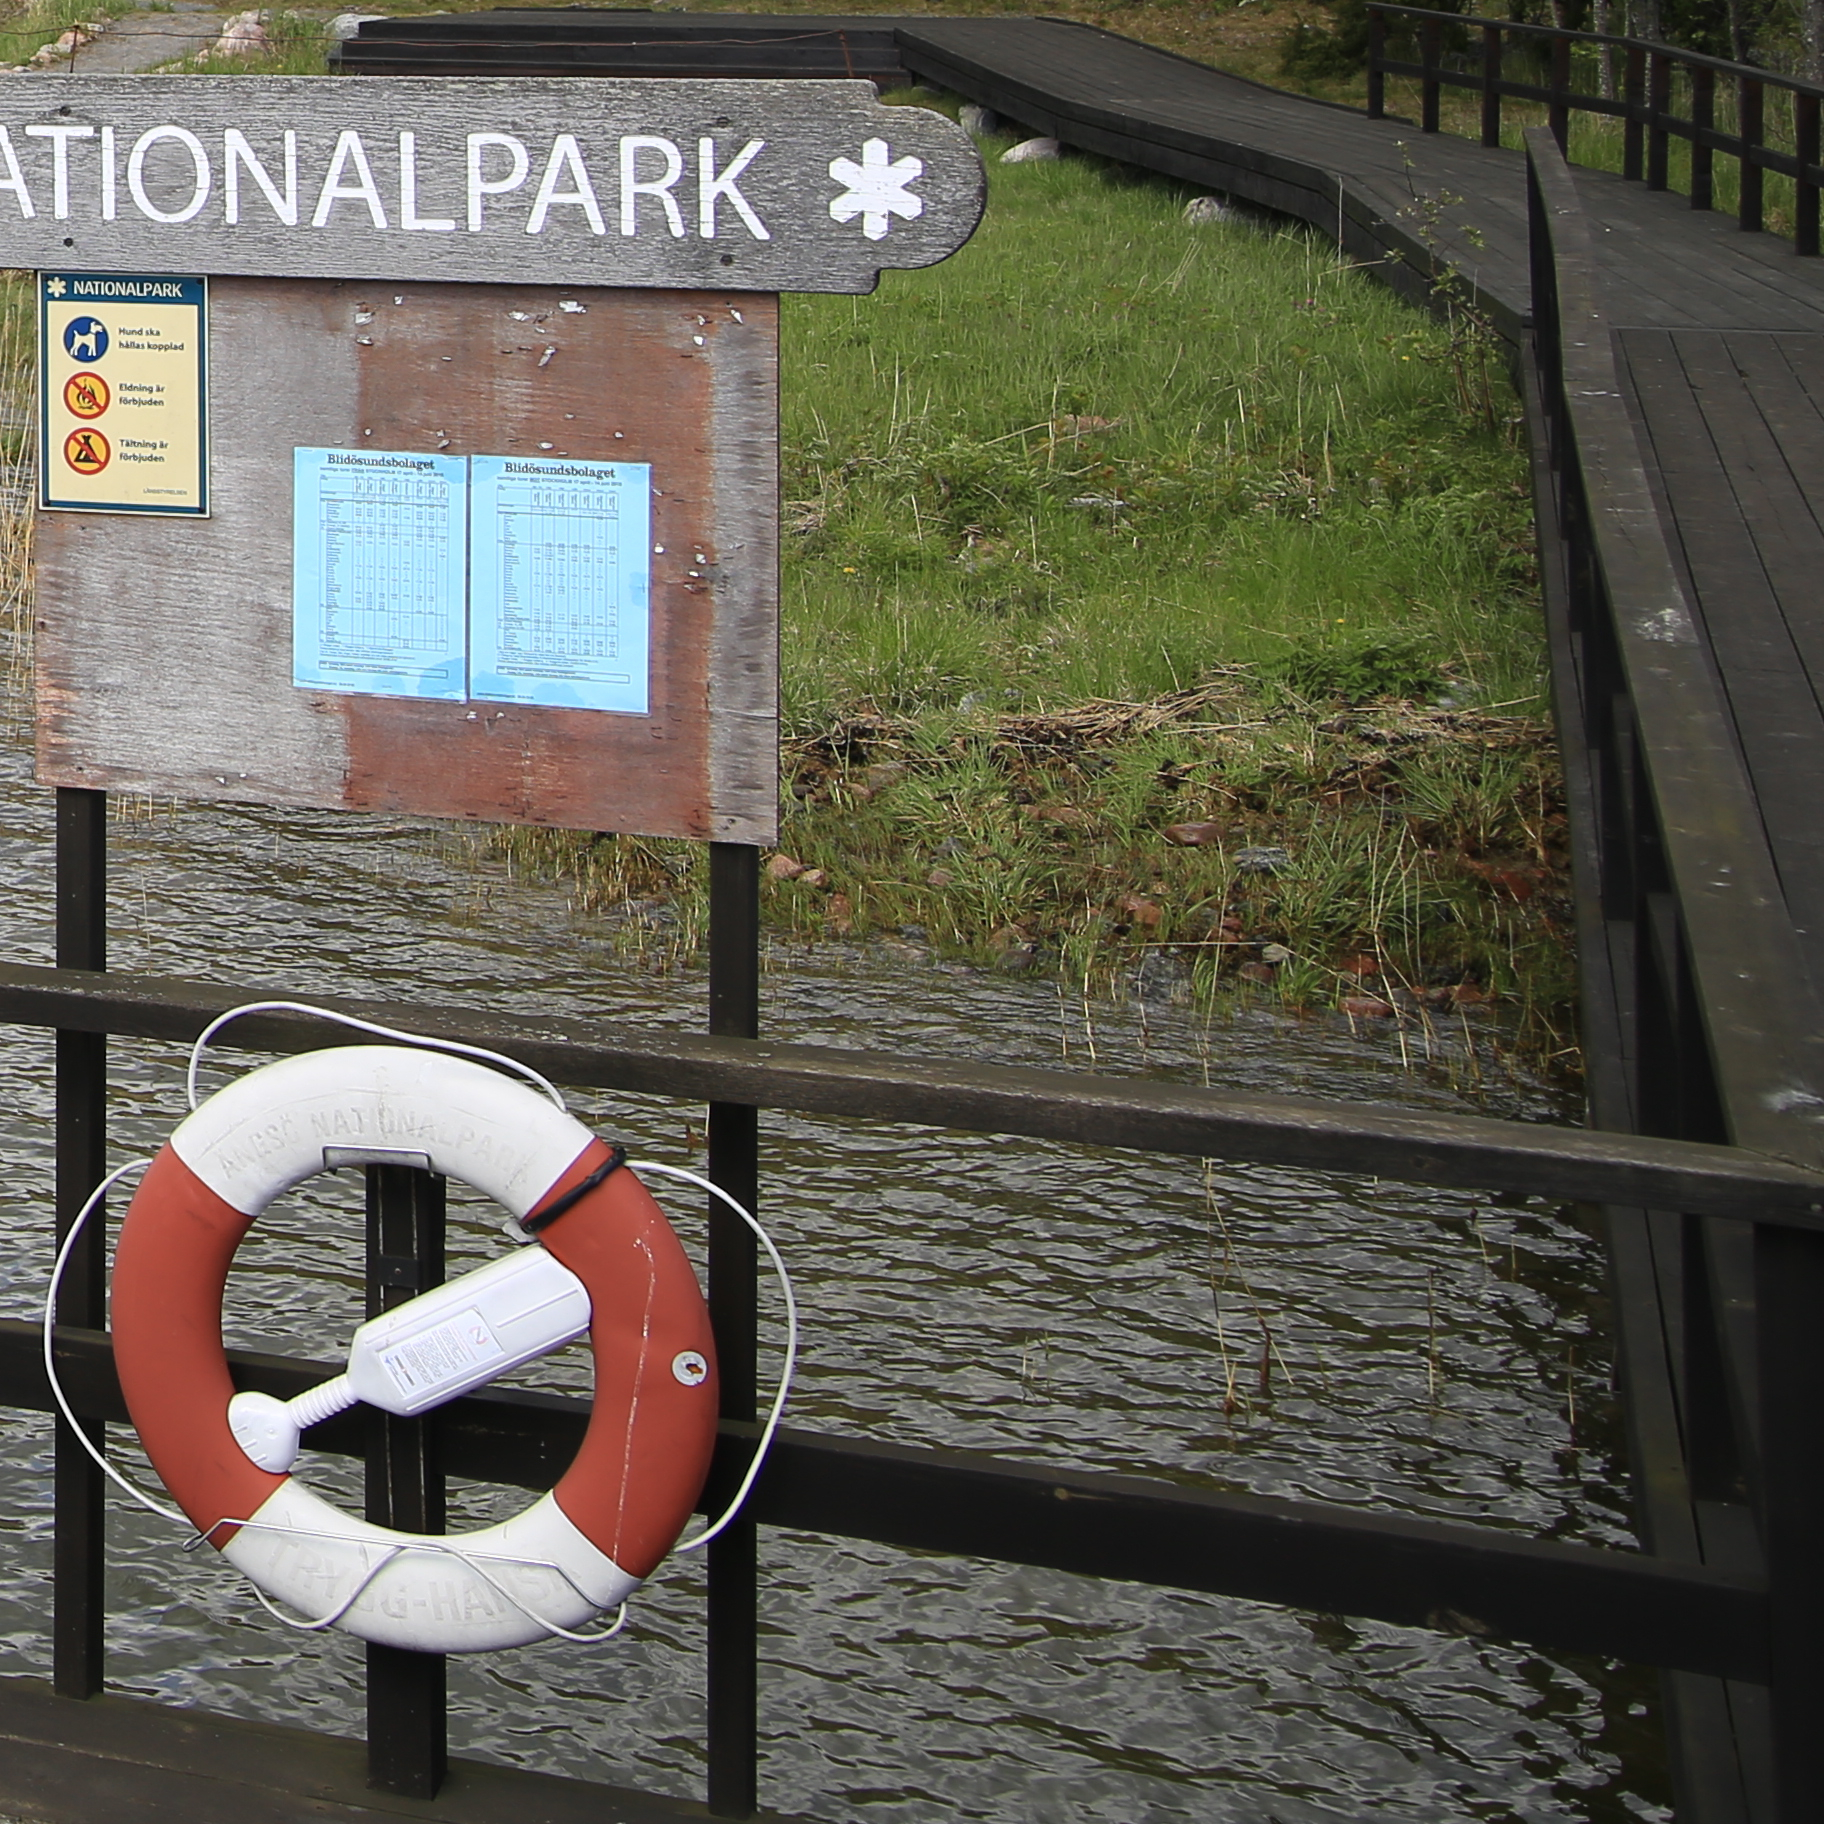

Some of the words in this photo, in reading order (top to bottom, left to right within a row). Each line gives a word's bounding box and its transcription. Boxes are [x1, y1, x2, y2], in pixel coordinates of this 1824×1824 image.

[73, 280, 183, 298] NATIONALPARK
[118, 327, 143, 336] Hund
[145, 328, 161, 337] ska
[118, 340, 145, 350] hållas
[147, 341, 185, 352] kopplad
[118, 383, 153, 394] Eldning
[155, 384, 165, 393] är
[118, 396, 164, 407] förbjuden
[119, 438, 158, 450] Tältning
[160, 440, 169, 449] är
[119, 452, 165, 463] förbjuden
[327, 453, 436, 471] Blidösundsbolaget
[504, 462, 616, 480] Blidösundsbolaget
[310, 1105, 540, 1188] NATIONALPARK
